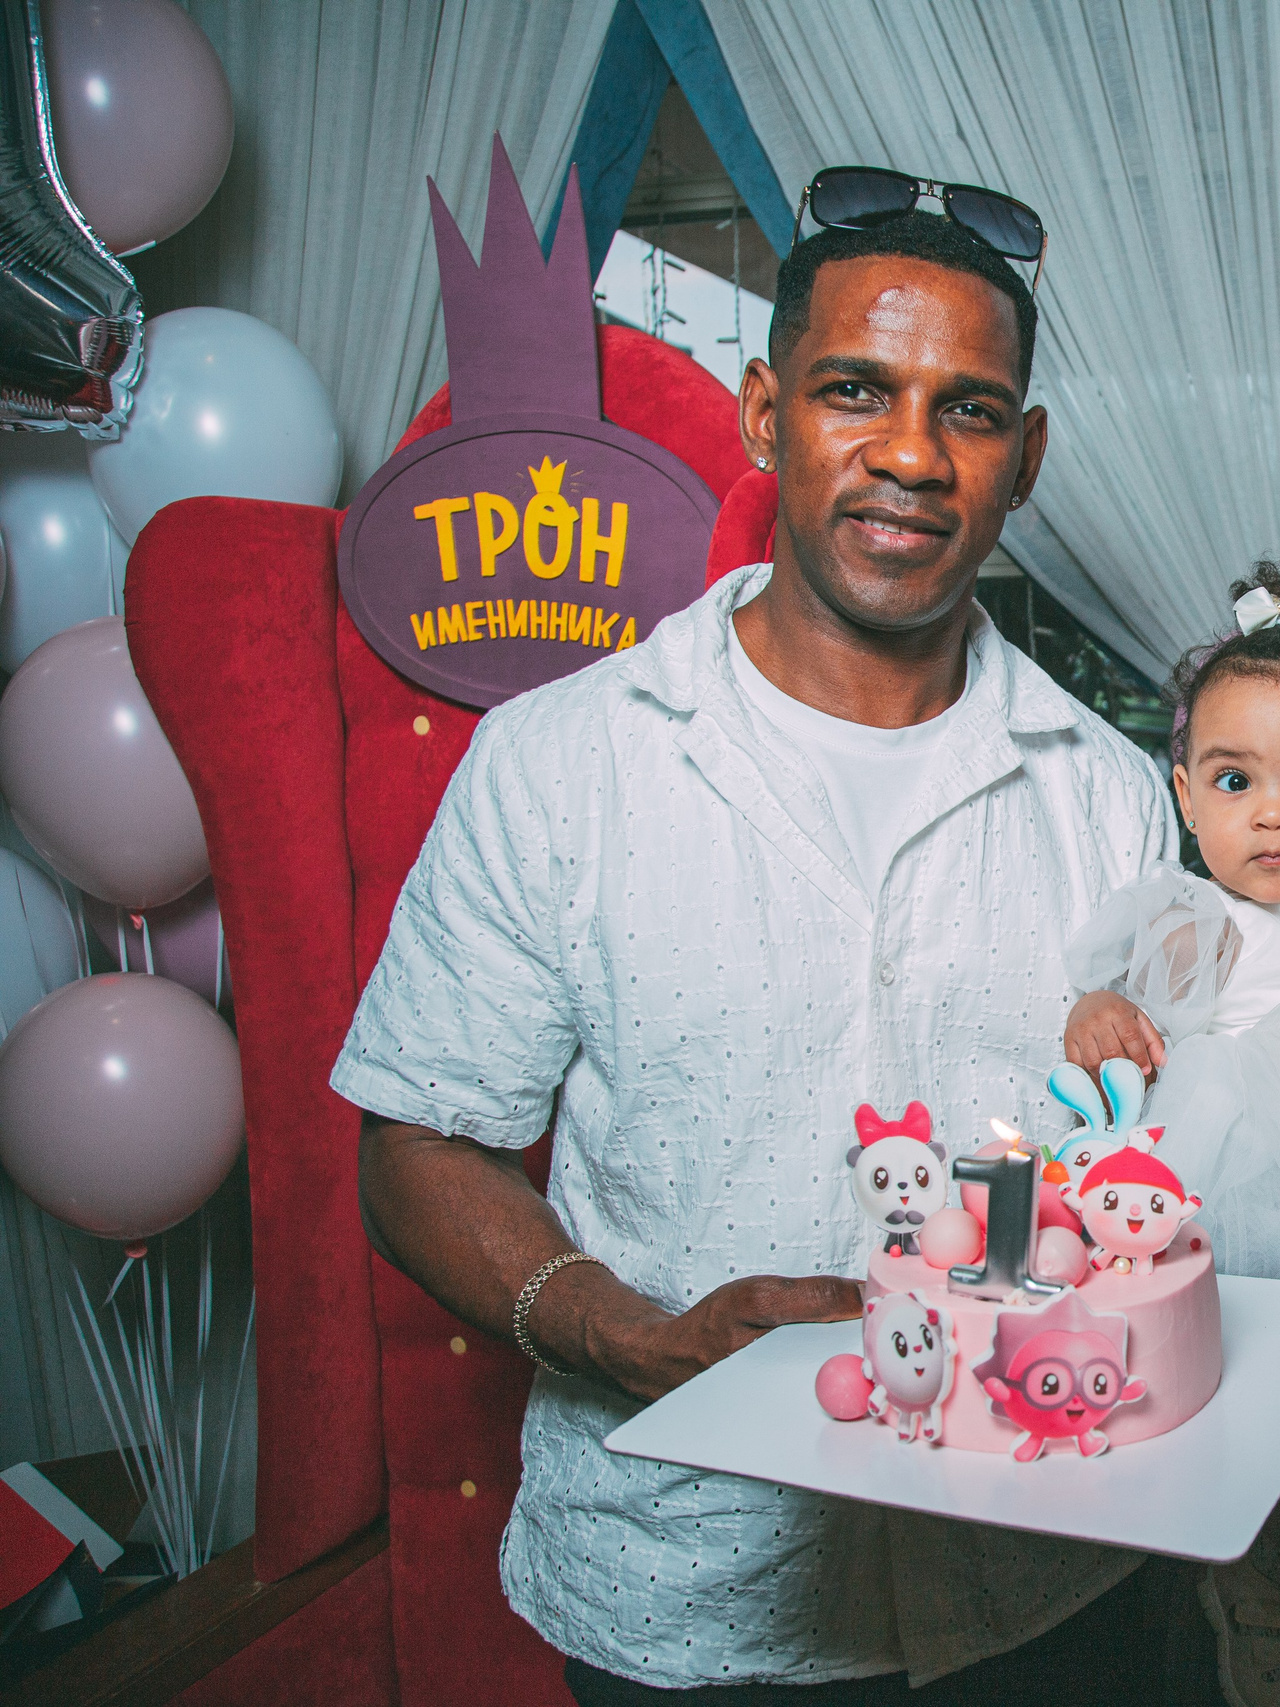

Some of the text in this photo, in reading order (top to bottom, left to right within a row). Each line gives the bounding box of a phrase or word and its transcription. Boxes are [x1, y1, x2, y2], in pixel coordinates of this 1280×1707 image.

[413, 490, 629, 588] ТРОН
[410, 599, 636, 652] ИМЕНИННИКА
[948, 1148, 1070, 1299] 1
